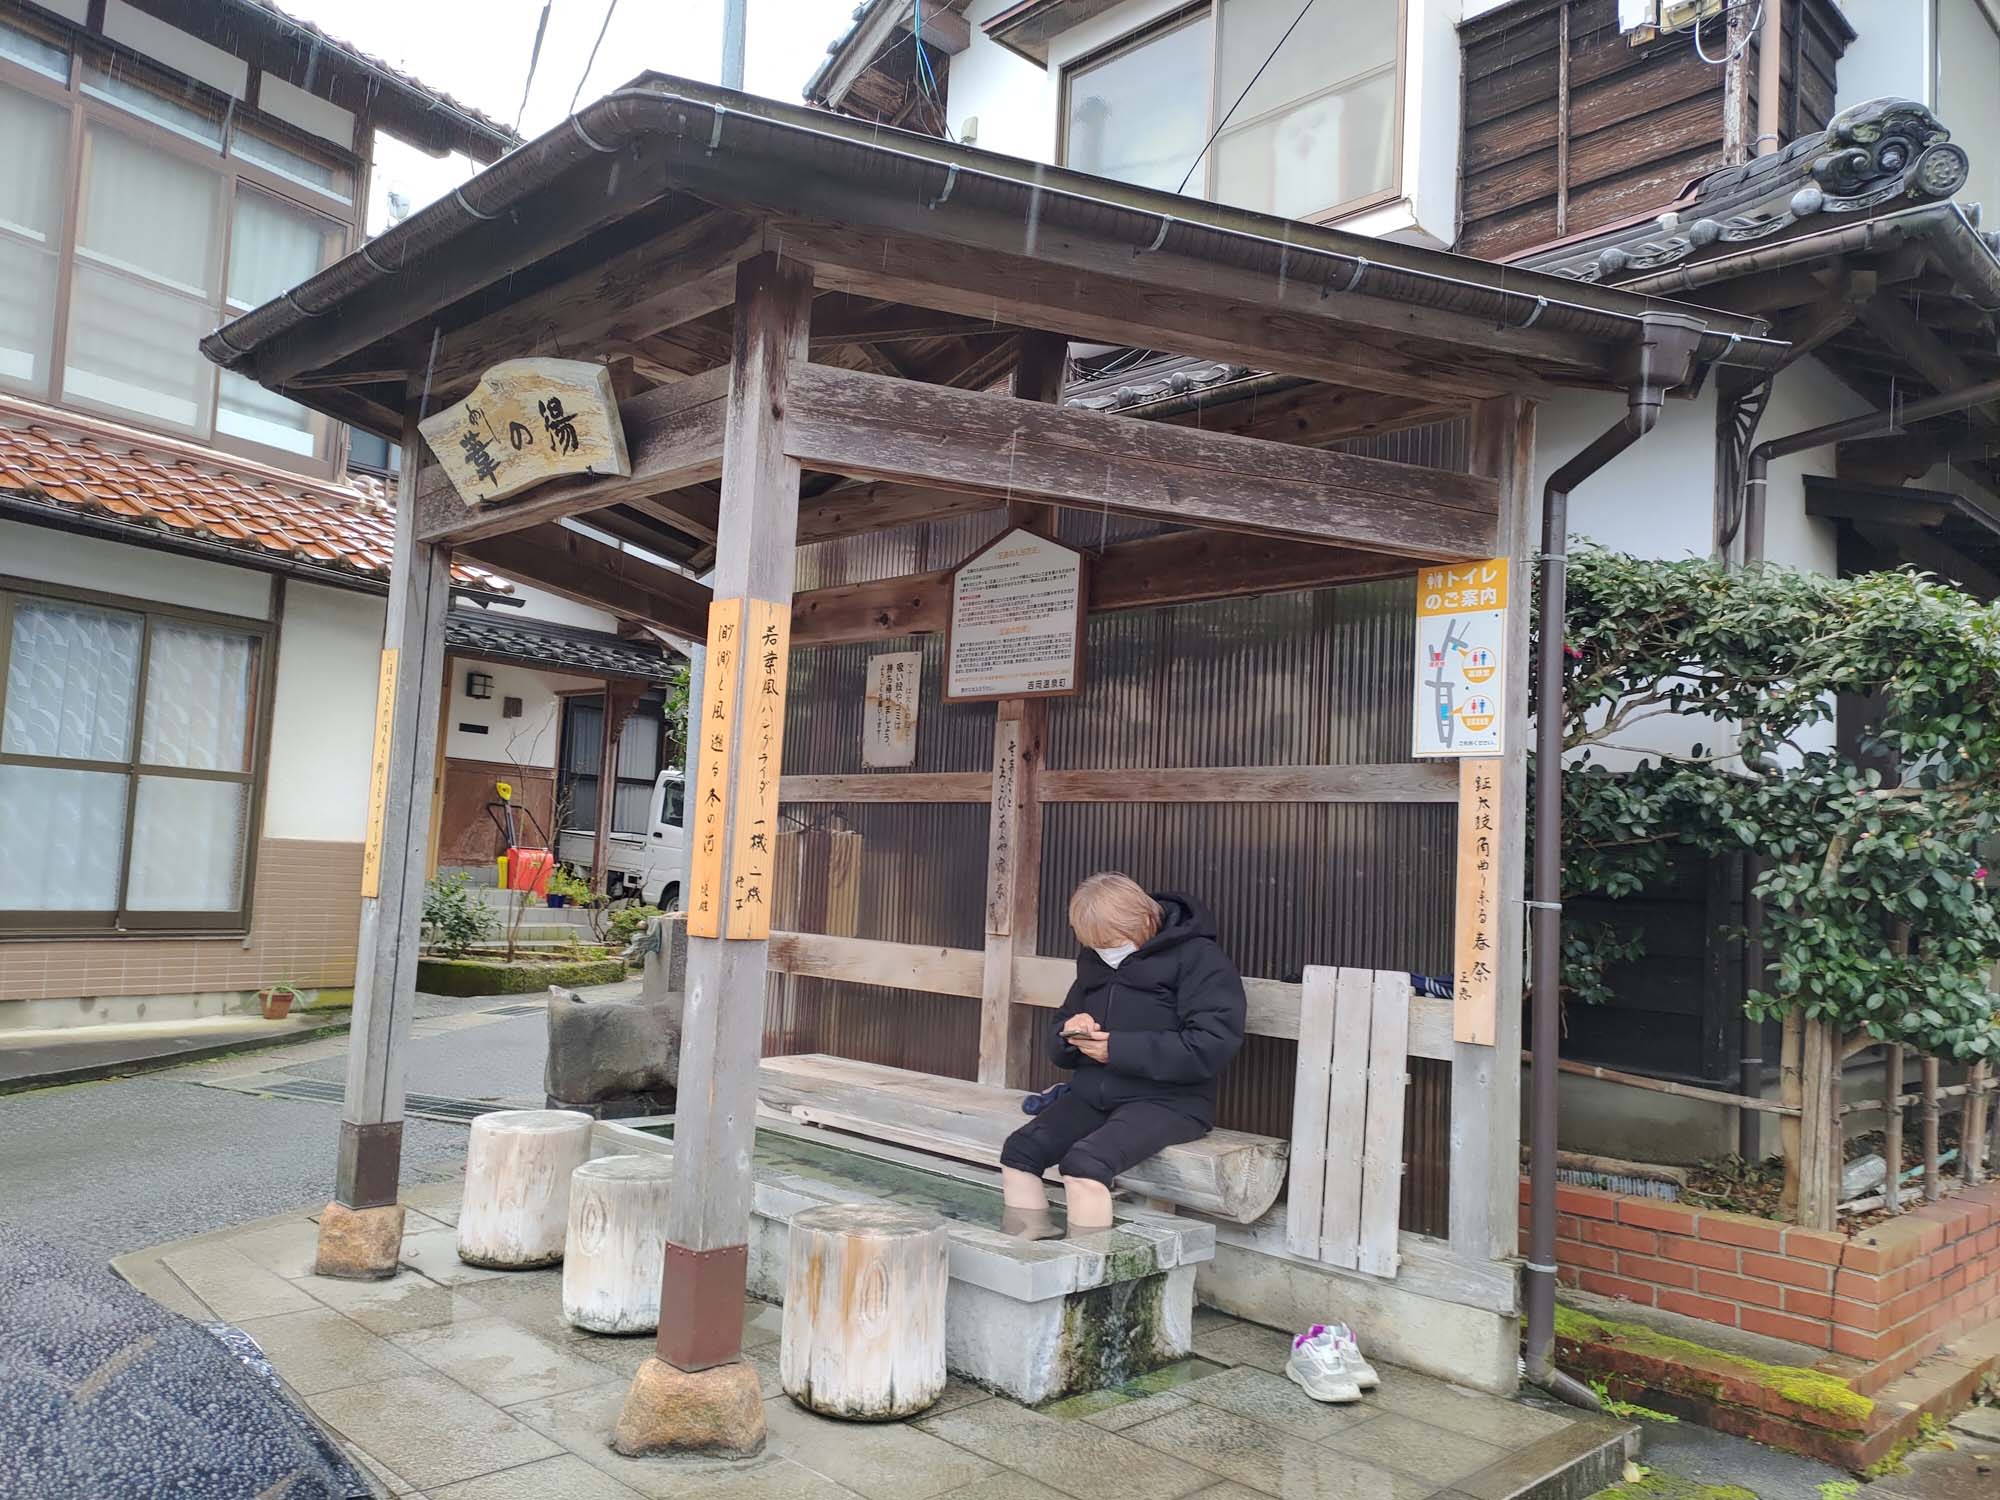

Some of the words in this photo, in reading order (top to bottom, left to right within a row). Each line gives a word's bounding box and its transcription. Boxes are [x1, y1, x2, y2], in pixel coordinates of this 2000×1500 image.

[1425, 587, 1497, 610] のご案内
[1027, 678, 1066, 690] 吉岡温泉町
